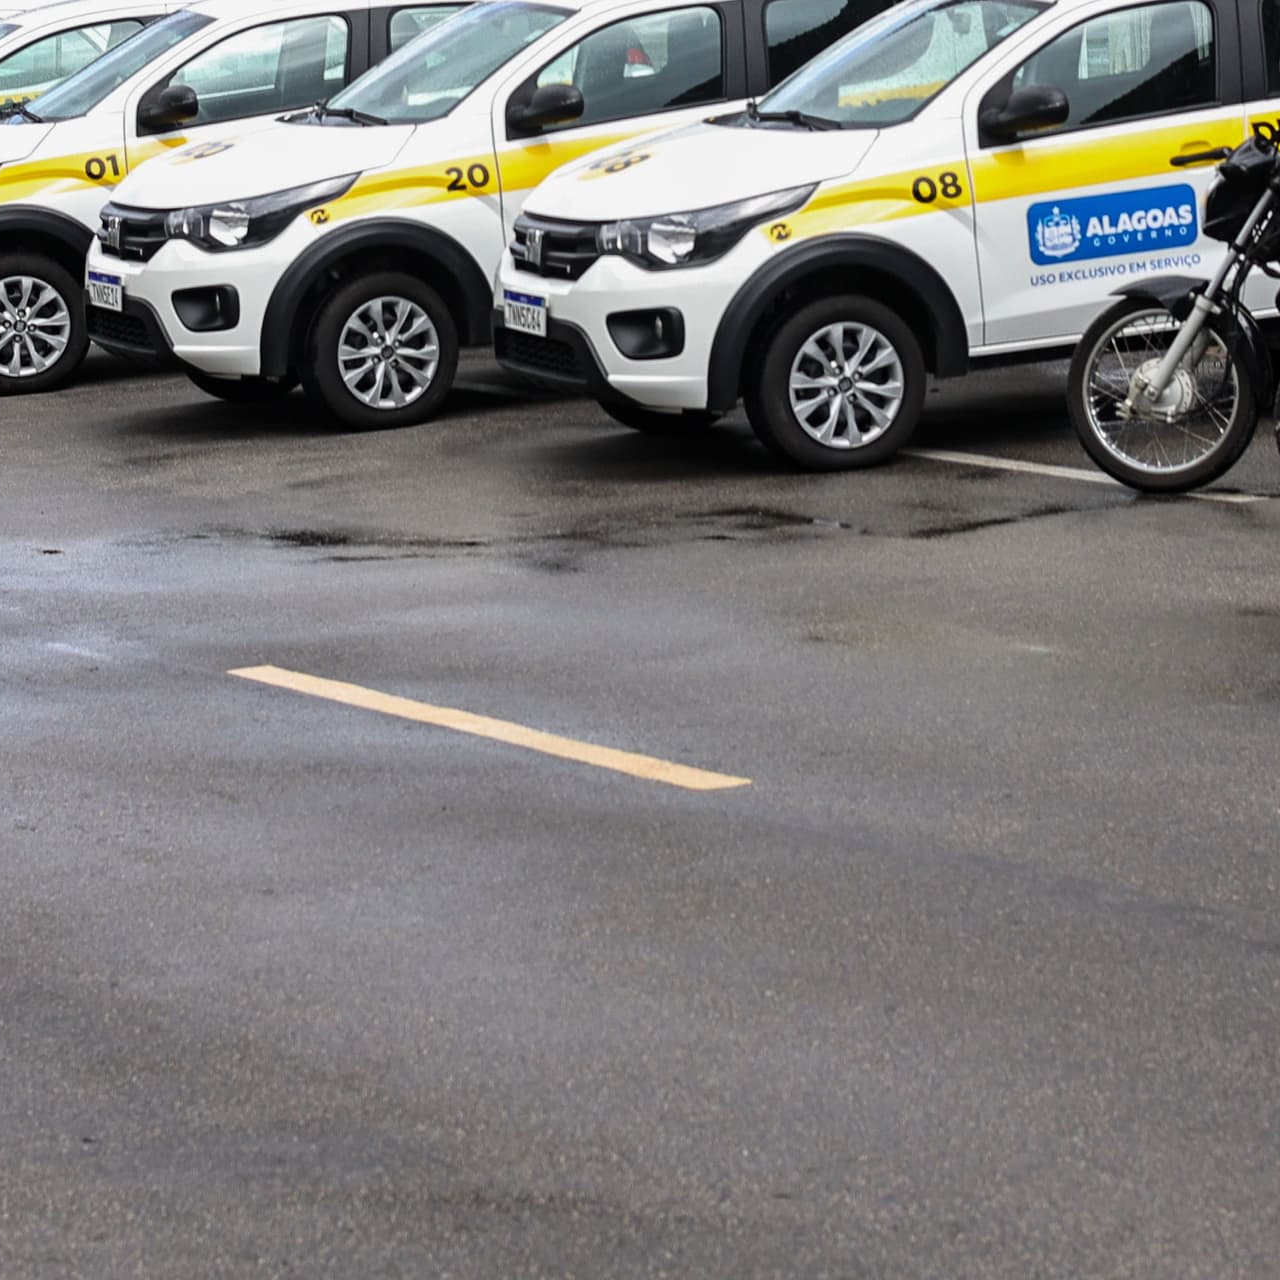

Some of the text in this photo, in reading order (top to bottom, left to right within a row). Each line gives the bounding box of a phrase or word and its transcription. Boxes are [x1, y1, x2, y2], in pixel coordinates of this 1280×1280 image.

[85, 154, 120, 180] 01
[445, 163, 490, 192] 20
[912, 172, 962, 203] 08
[1086, 204, 1193, 237] ALAGOAS
[1094, 227, 1187, 246] GOVERNO
[1030, 254, 1201, 287] USO EXCLUSIVO EM SERVIÇO
